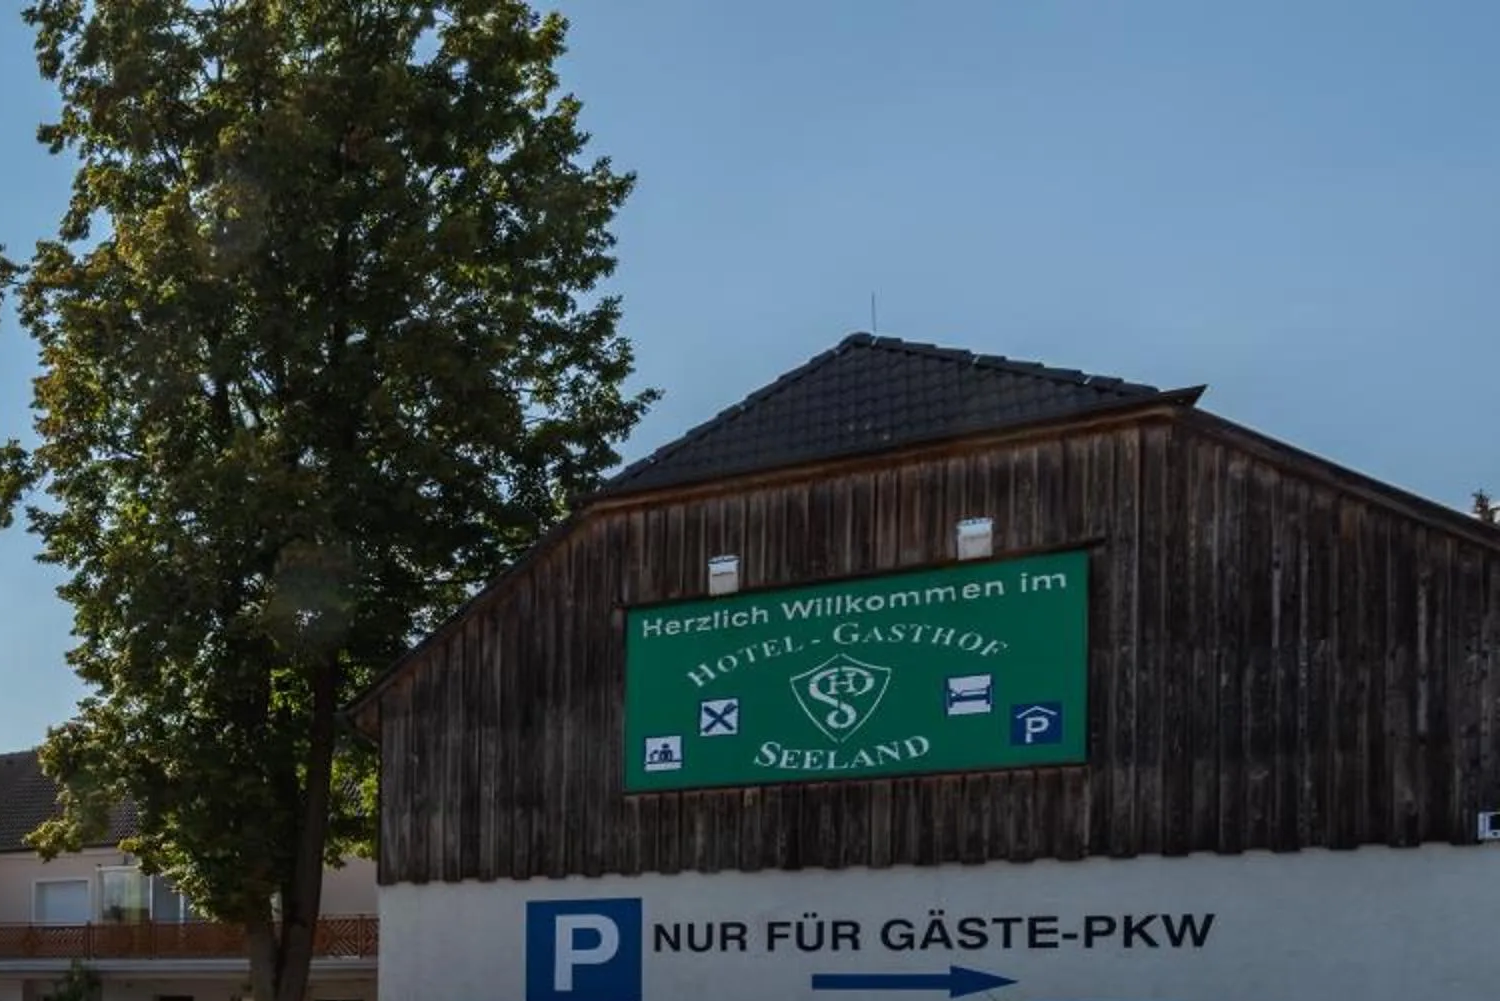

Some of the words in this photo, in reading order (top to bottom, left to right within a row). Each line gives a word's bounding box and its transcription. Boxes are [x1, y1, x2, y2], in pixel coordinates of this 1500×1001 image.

[642, 606, 769, 638] Herzlich
[781, 574, 1004, 621] Willkommen
[1019, 571, 1067, 594] im
[686, 635, 804, 688] HOTEL
[832, 622, 1009, 658] GASTHOF
[753, 735, 931, 770] SEELAND
[1025, 715, 1050, 744] P
[553, 914, 621, 992] P
[653, 920, 748, 953] NUR
[766, 912, 862, 952] FÜR
[879, 908, 1216, 951] GÄSTE-PKW
